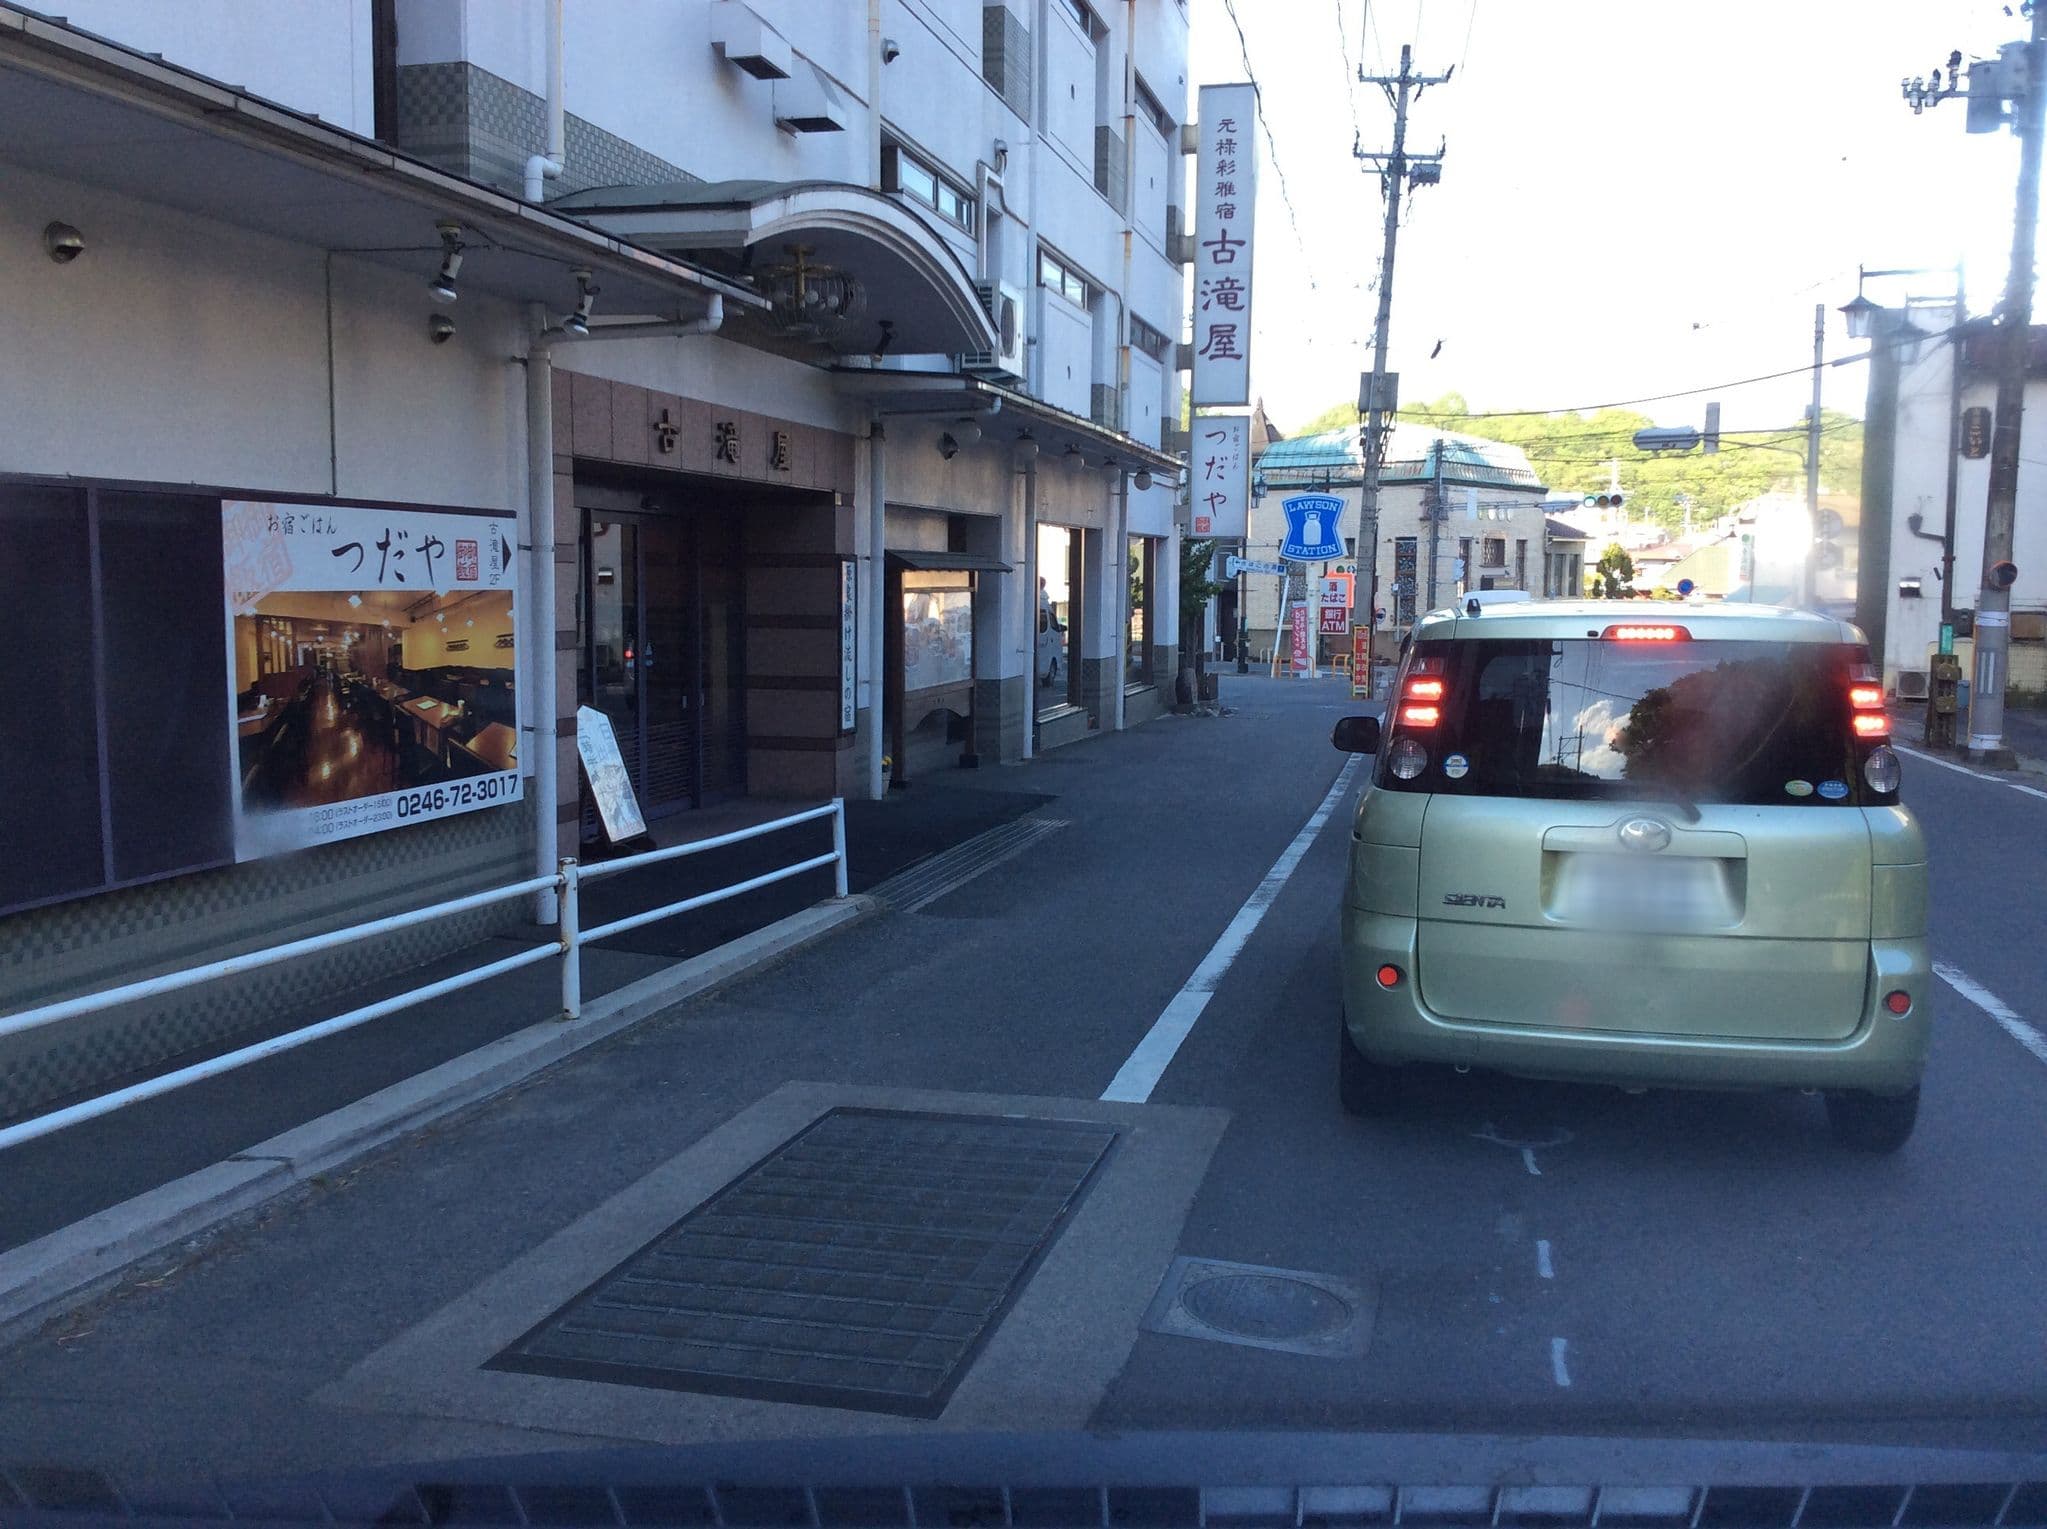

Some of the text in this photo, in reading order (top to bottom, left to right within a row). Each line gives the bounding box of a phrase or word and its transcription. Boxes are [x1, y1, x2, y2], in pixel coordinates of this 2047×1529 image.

[1199, 228, 1246, 361] 古滝屋
[654, 408, 793, 472] 古滝屋
[1203, 430, 1228, 518] つだや
[1288, 500, 1339, 512] LAWSON
[267, 512, 338, 535] お宿ごはん
[331, 527, 446, 585] つだや
[1287, 544, 1338, 555] STATION
[1322, 621, 1345, 632] ATM
[1325, 609, 1342, 620] 銀行
[397, 774, 518, 818] 0246-72-3017
